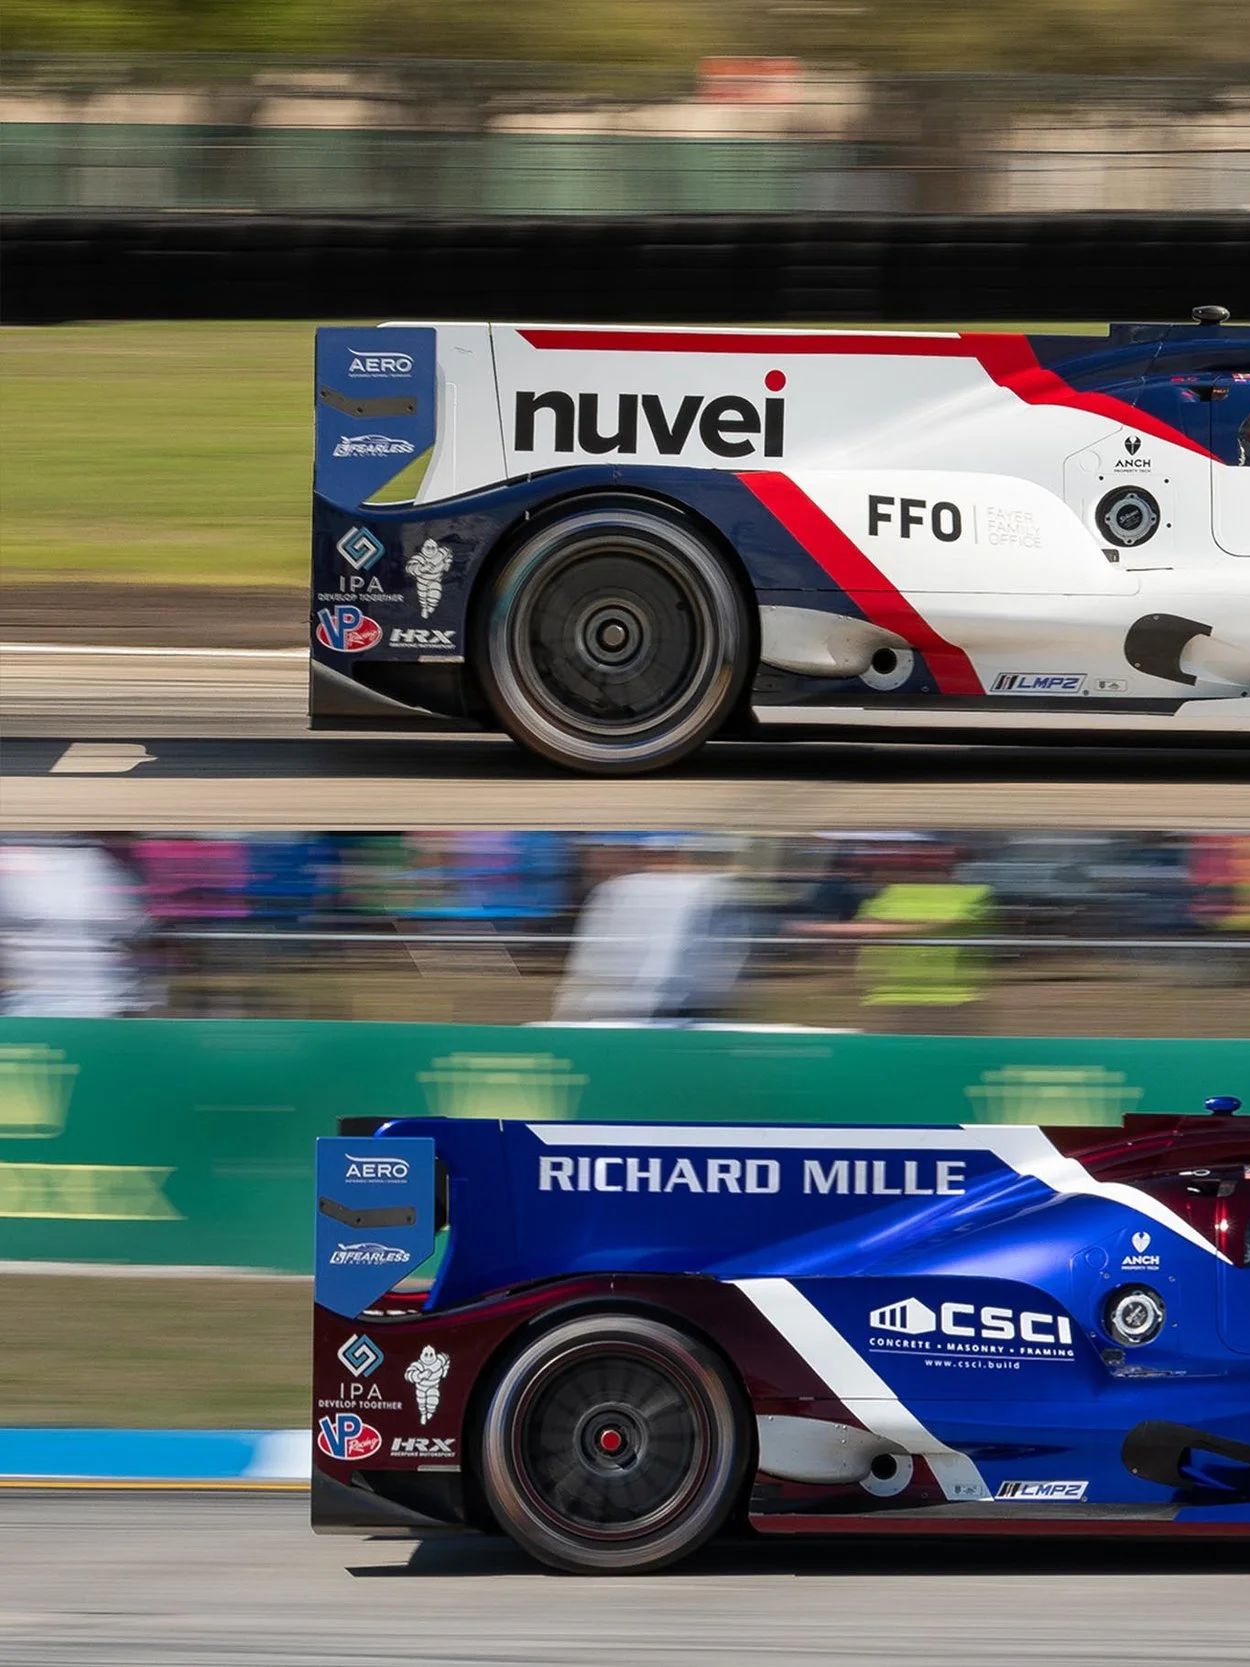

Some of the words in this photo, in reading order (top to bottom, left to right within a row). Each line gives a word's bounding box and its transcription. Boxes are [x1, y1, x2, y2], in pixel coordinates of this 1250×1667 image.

[349, 358, 412, 372] AERO
[514, 369, 787, 458] nuvei
[1115, 459, 1151, 468] ANCH
[868, 494, 962, 542] FFO
[988, 532, 1042, 548] OFFICE
[340, 576, 384, 593] IPA
[317, 605, 362, 651] VP
[390, 628, 456, 644] HRX
[1017, 677, 1080, 688] LMP2
[346, 1164, 408, 1178] AERO
[539, 1156, 780, 1193] RICHARD
[804, 1160, 966, 1195] MILLE
[346, 1251, 411, 1263] FEARLESS
[1121, 1255, 1160, 1265] ANCH
[941, 1302, 1072, 1344] CSCI
[869, 1337, 931, 1349] CONCRETE
[947, 1343, 1004, 1353] MASONRY
[1019, 1347, 1074, 1357] FRAMING
[925, 1359, 1020, 1369] www.csci.build
[340, 1383, 382, 1400] IPA
[318, 1400, 357, 1408] DEVELOP
[360, 1400, 402, 1409] TOGETHER
[318, 1413, 363, 1459] VP
[348, 1438, 378, 1455] Racing
[391, 1438, 456, 1452] HRX
[1022, 1485, 1081, 1495] LMP2
